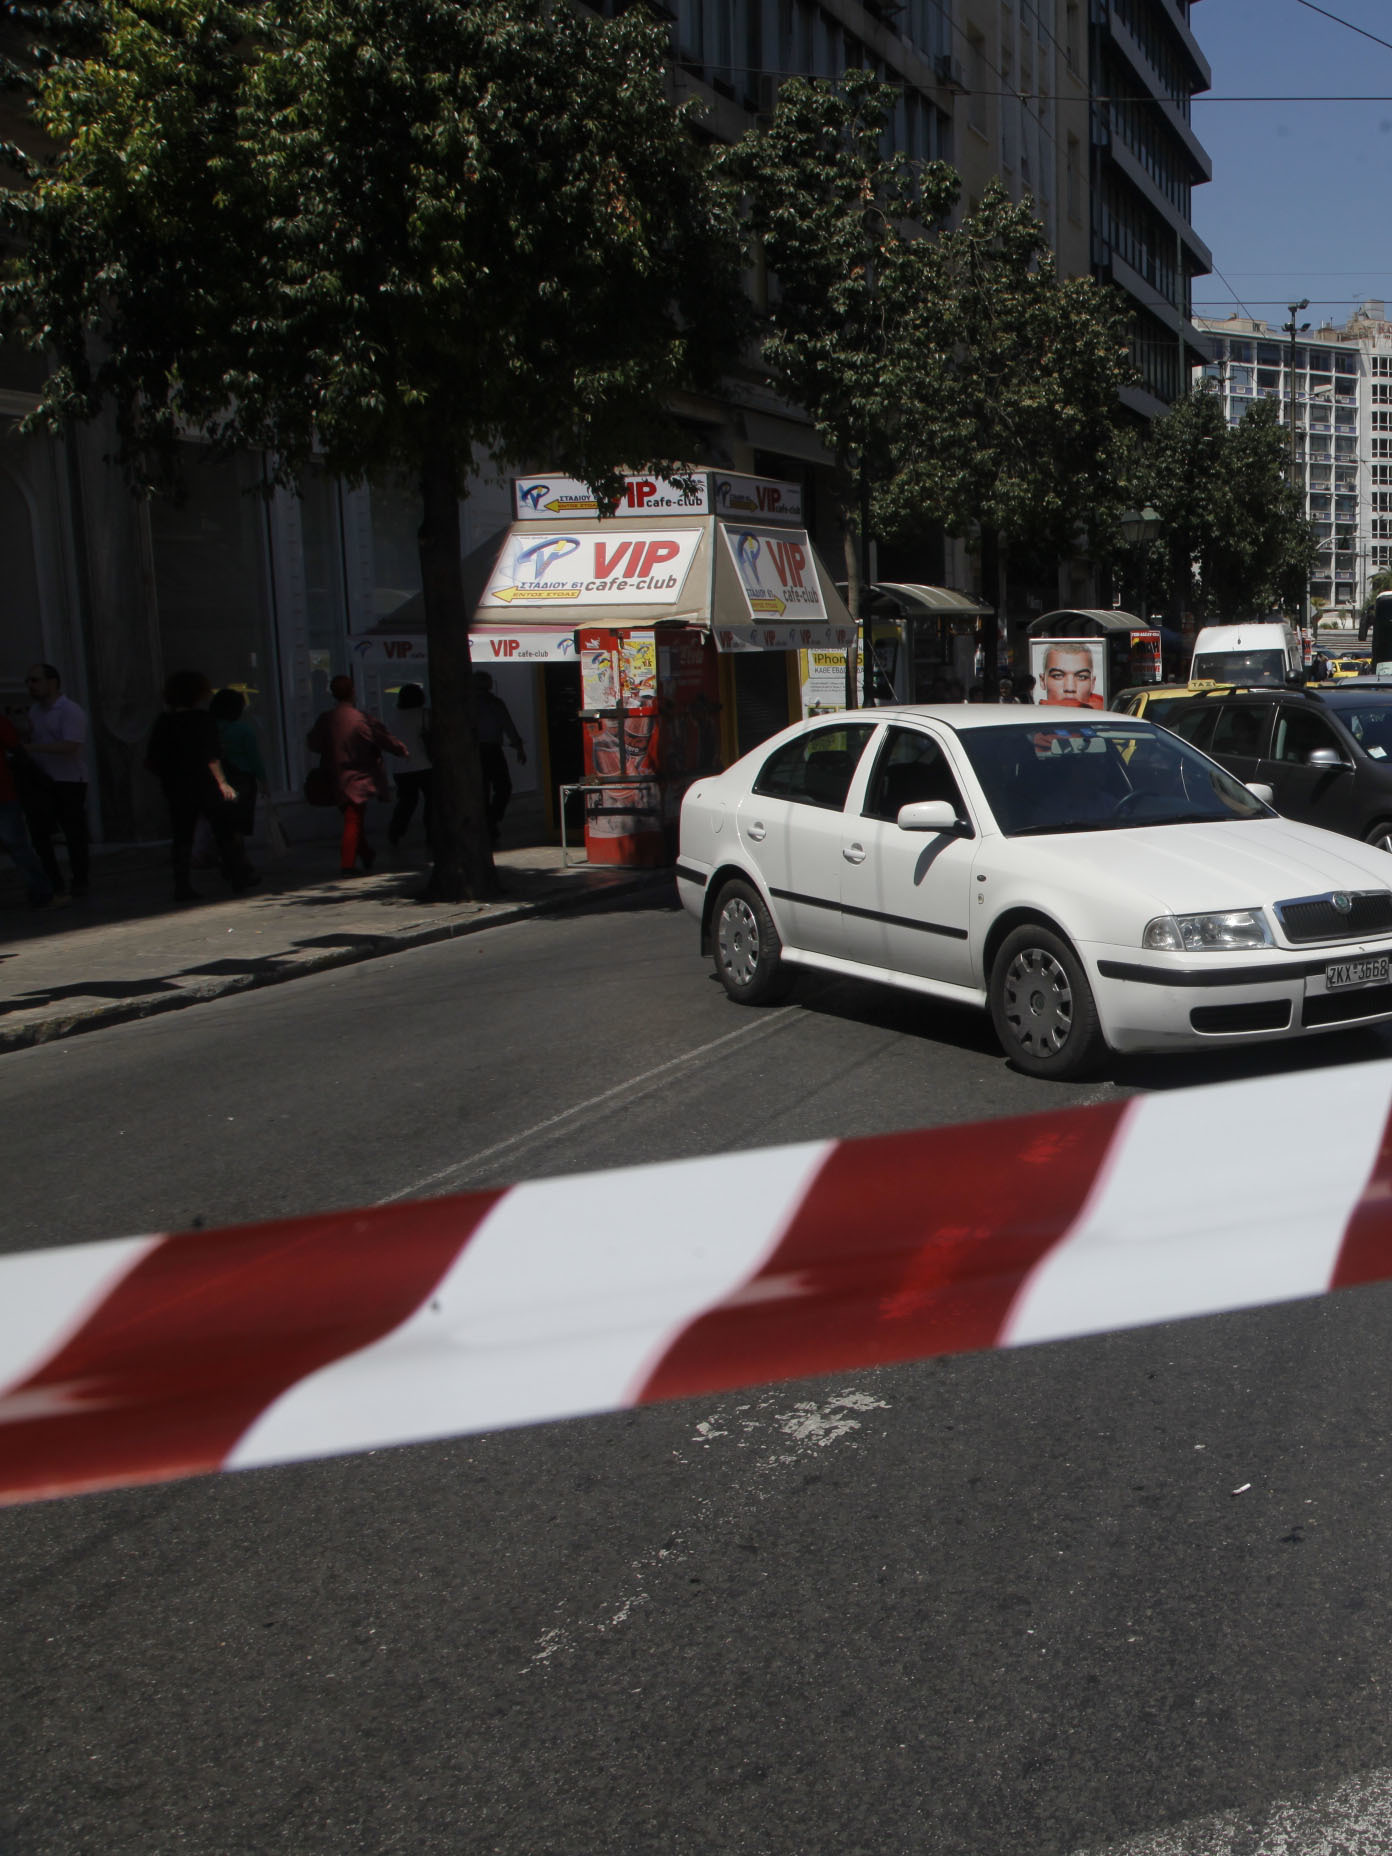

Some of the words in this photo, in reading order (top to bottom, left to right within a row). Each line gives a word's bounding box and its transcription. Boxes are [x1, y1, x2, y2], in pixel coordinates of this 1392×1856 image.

[646, 497, 703, 508] cafe-club
[755, 485, 781, 512] VIP
[594, 540, 680, 579] VIP
[765, 540, 806, 587] VIP
[519, 581, 568, 589] ΣΤΑΔΙΟΥ
[571, 581, 584, 589] 61
[584, 575, 678, 592] cafe-club
[782, 586, 819, 604] cafe-club
[383, 640, 413, 658] VIP
[489, 639, 521, 657] VIP
[517, 645, 549, 658] cafe-club
[814, 653, 849, 664] iPhon
[1328, 959, 1388, 985] ZKX-3668
